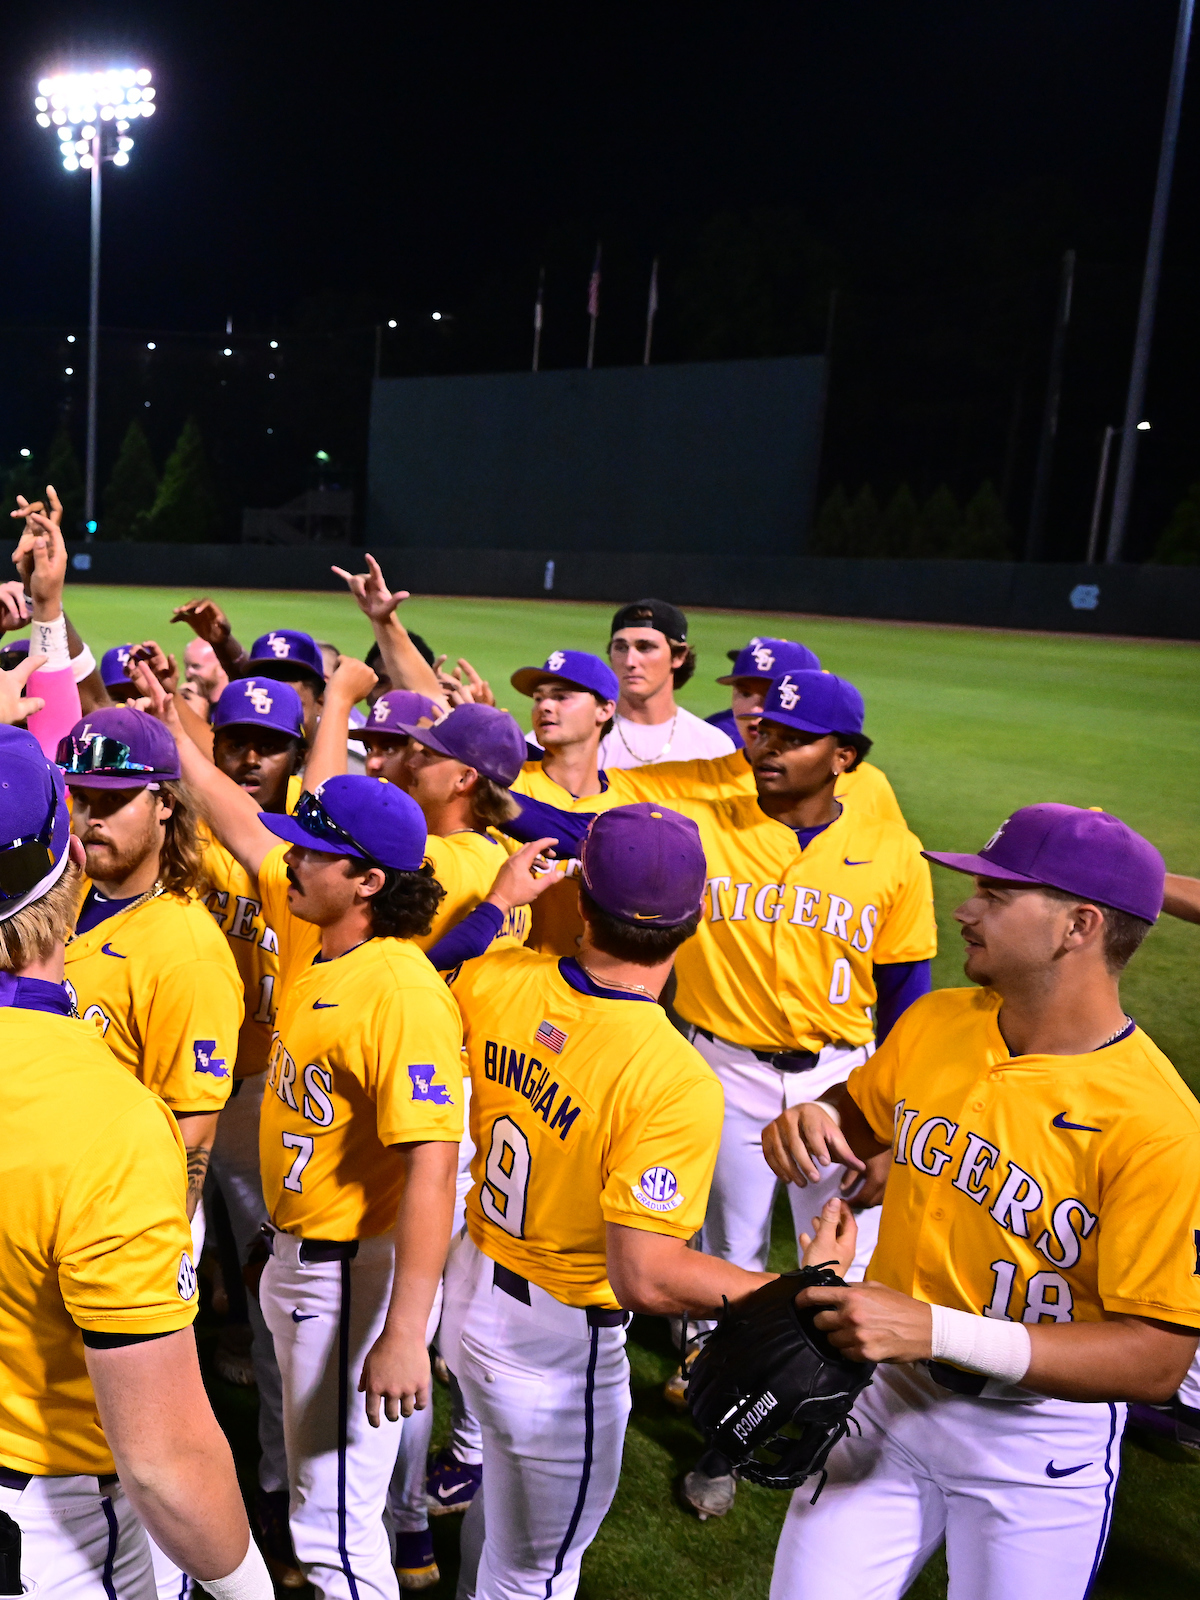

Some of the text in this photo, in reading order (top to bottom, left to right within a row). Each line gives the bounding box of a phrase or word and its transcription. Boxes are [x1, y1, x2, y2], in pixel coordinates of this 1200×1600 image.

[267, 632, 291, 658] LSU
[751, 642, 775, 671] LSU
[244, 681, 273, 714] LSU
[373, 696, 391, 723] LSU
[778, 675, 801, 710] LSU
[705, 876, 878, 953] TIGERS
[829, 958, 852, 1004] 0
[197, 1049, 209, 1067] LSU
[415, 1075, 429, 1094] LSU
[484, 1040, 582, 1141] BINGHAM
[282, 1131, 314, 1193] 7
[480, 1114, 532, 1240] 9
[641, 1167, 677, 1201] SEC
[635, 1192, 678, 1211] GRADUATE
[983, 1259, 1074, 1323] 18
[733, 1391, 778, 1445] marucci
